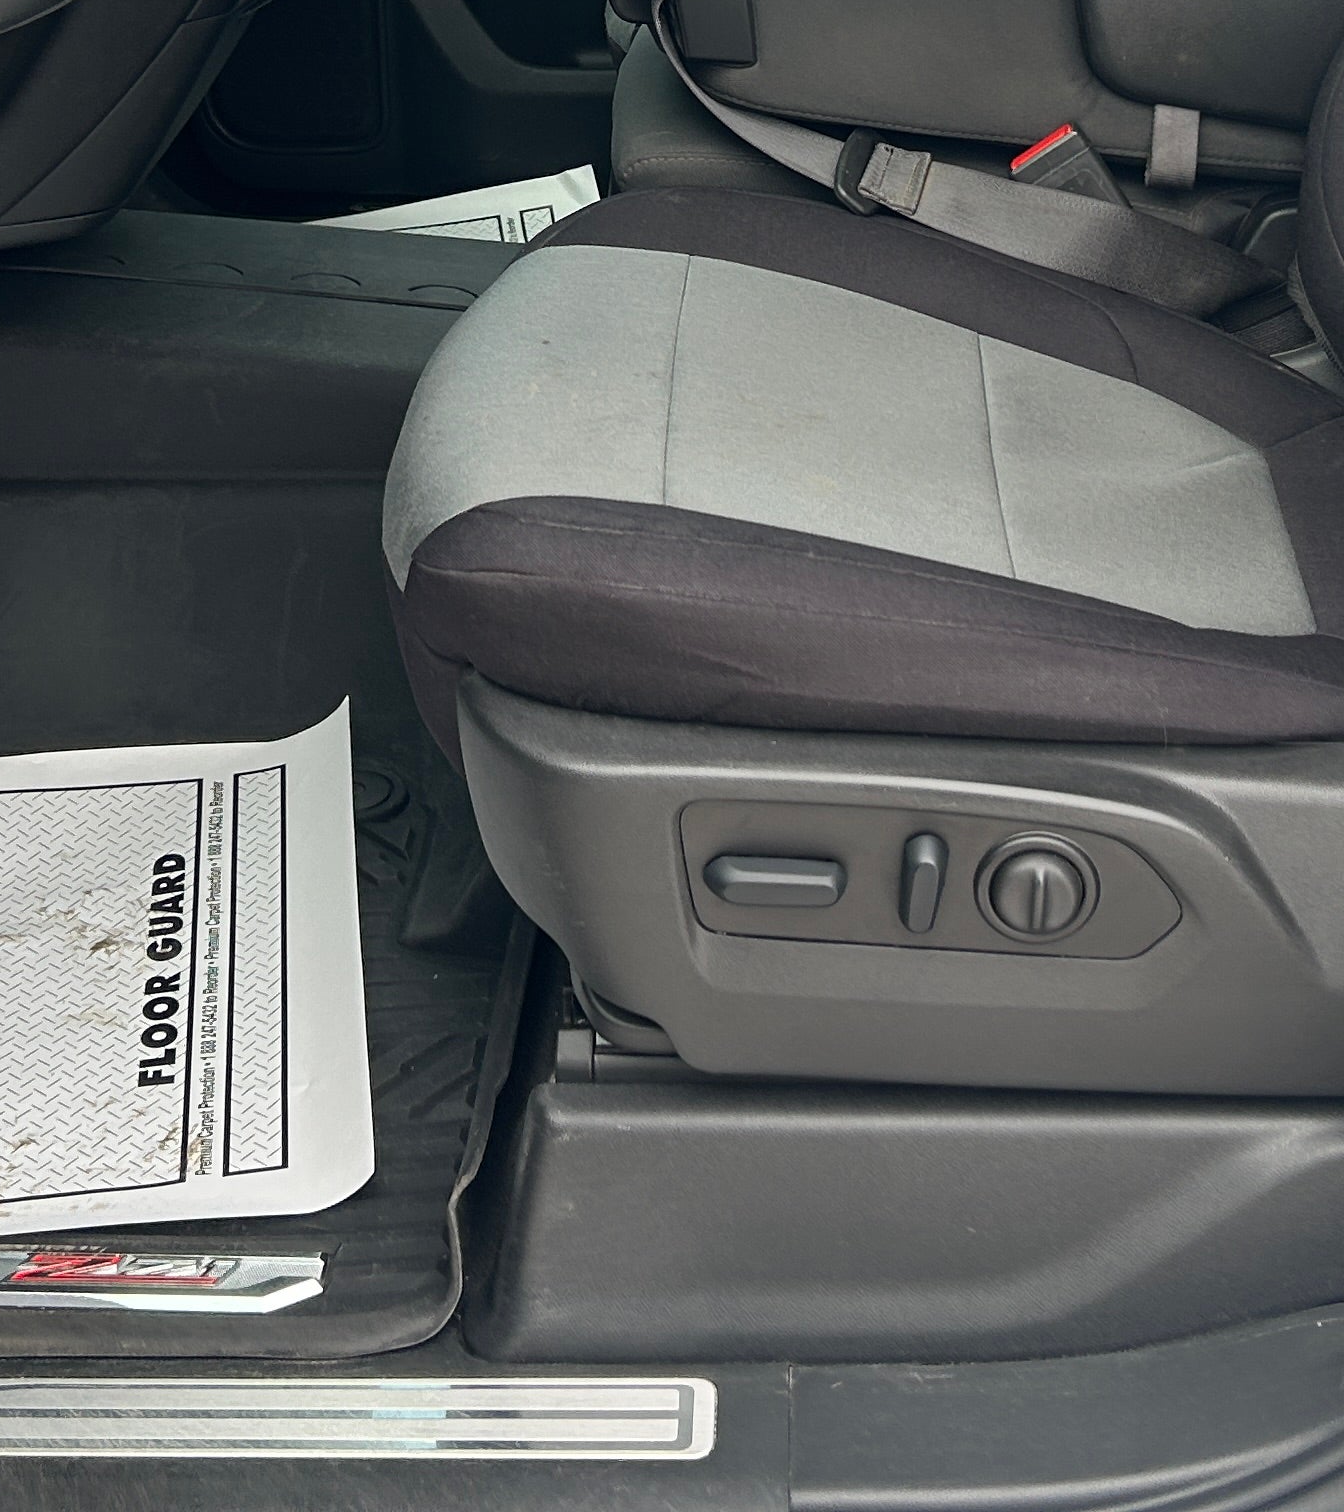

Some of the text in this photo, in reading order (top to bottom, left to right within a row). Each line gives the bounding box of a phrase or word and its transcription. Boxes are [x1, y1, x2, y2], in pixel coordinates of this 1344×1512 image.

[206, 866, 221, 903] Protection
[205, 903, 223, 926] Carpet
[204, 927, 220, 959] Premium
[137, 853, 186, 1088] FLOOR GUARD
[202, 965, 218, 995] Reorder
[198, 1066, 215, 1109] Protection
[197, 1109, 218, 1138] Carpet
[195, 1139, 213, 1175] Premium
